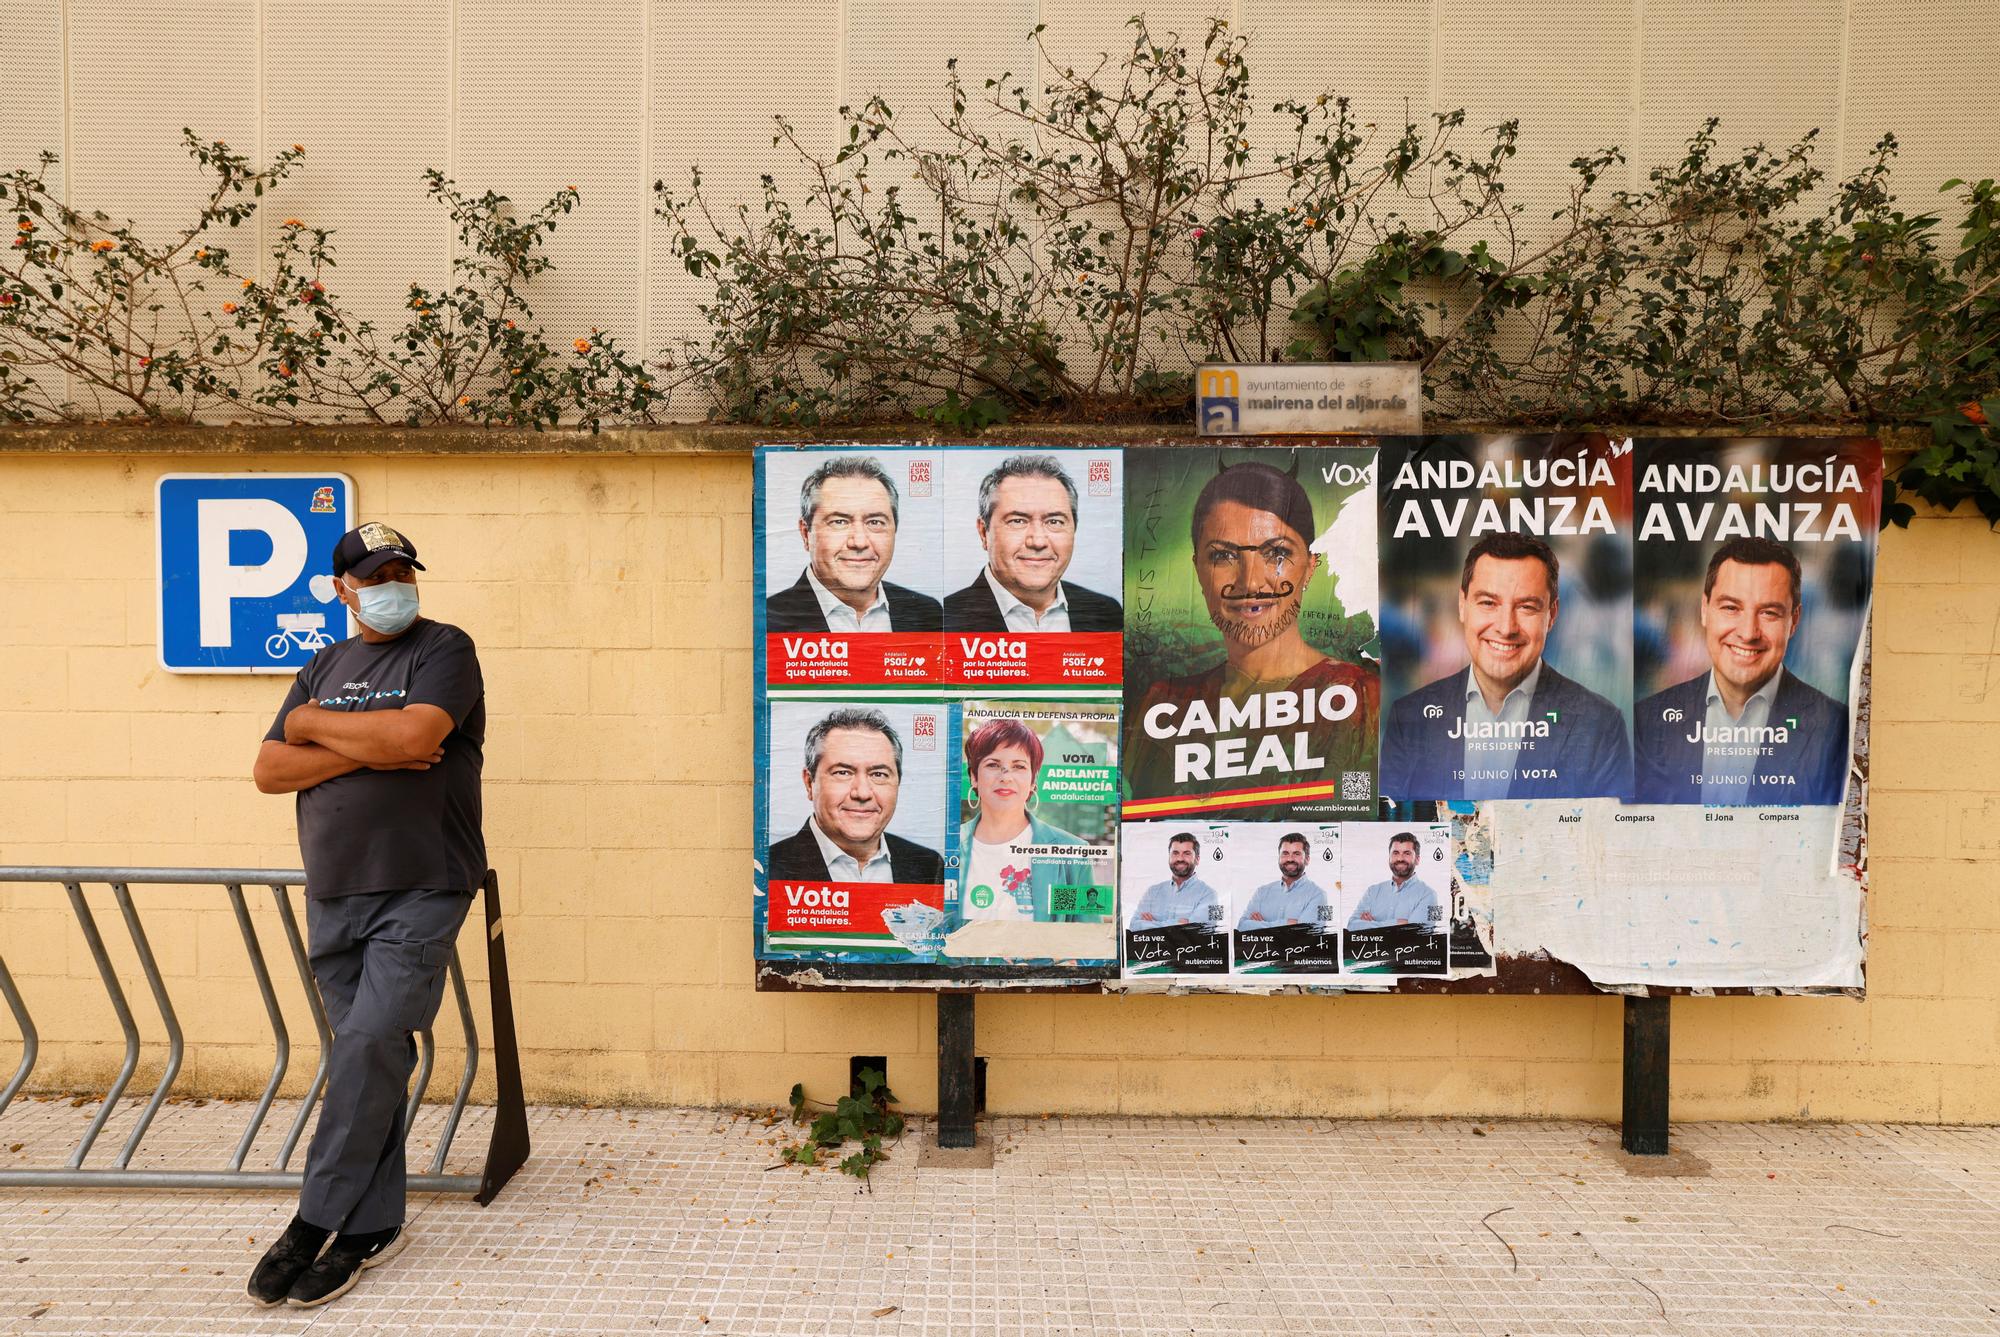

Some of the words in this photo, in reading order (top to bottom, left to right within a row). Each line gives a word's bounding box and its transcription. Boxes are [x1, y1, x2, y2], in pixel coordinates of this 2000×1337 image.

[1247, 380, 1327, 392] ayuntamiento
[1330, 379, 1345, 391] de
[1247, 396, 1313, 410] mairena
[1317, 395, 1342, 410] del
[1346, 395, 1407, 413] aljarafe
[910, 467, 930, 475] ESPA
[1321, 462, 1371, 487] VOX
[1392, 448, 1616, 490] ANDALUCÍA
[1638, 454, 1863, 493] ANDALUCÍA
[910, 474, 930, 482] DAS
[1089, 474, 1110, 482] DAS
[1392, 496, 1617, 539] AVANZA
[1638, 502, 1863, 542] AVANZA
[198, 499, 308, 647] P
[782, 637, 849, 659] Vota
[960, 637, 1027, 659] Vota
[884, 657, 907, 666] PSOE
[1063, 657, 1086, 666] PSOE
[786, 669, 807, 680] que
[809, 667, 852, 679] quieres.
[904, 668, 928, 676] lado.
[963, 669, 984, 680] que
[986, 667, 1029, 679] quieres.
[1063, 669, 1070, 677] A
[1083, 668, 1107, 676] lado.
[967, 709, 1020, 718] ANDALUCÍA
[1037, 711, 1078, 720] DEFENSA
[1080, 712, 1115, 721] PROPIA
[1143, 684, 1358, 740] CAMBIO
[914, 728, 934, 736] DAS
[1447, 716, 1549, 739] Juanma
[1686, 720, 1788, 744] Juanma
[1468, 741, 1536, 752] PRESIDENTE
[1706, 747, 1774, 756] PRESIDENTE
[1062, 754, 1095, 764] VOTA
[1174, 731, 1325, 784] REAL
[1047, 768, 1110, 779] ADELANTE
[1452, 770, 1465, 780] 19
[1470, 769, 1509, 780] JUNIO
[1521, 769, 1558, 779] VOTA
[1690, 774, 1703, 785] 19
[1708, 774, 1748, 785] JUNIO
[1760, 775, 1796, 785] VOTA
[1042, 780, 1113, 792] ANDALUCÍA
[1050, 793, 1104, 801] andalucistas
[1291, 804, 1370, 812] www.cambioreal.es
[1558, 814, 1582, 823] Autor
[1614, 813, 1655, 824] Comparsa
[1705, 813, 1713, 821] El
[1714, 813, 1734, 822] Jona
[1758, 813, 1800, 823] Comparsa
[1009, 845, 1048, 855] Teresa
[1051, 845, 1108, 857] Rodríguez
[784, 885, 850, 908] Vota
[787, 909, 801, 917] por
[809, 908, 849, 916] Andalucía
[787, 917, 808, 927] que
[809, 916, 852, 927] quieres.
[1241, 934, 1258, 942] Esta
[1351, 934, 1368, 942] Esta
[1134, 943, 1171, 961] Vota
[1176, 945, 1202, 962] por
[1207, 935, 1220, 949] ti
[1242, 942, 1280, 960] Vota
[1284, 945, 1310, 962] por
[1316, 935, 1328, 949] ti
[1351, 943, 1390, 960] Vota
[1394, 945, 1420, 962] por
[1426, 936, 1438, 950] ti
